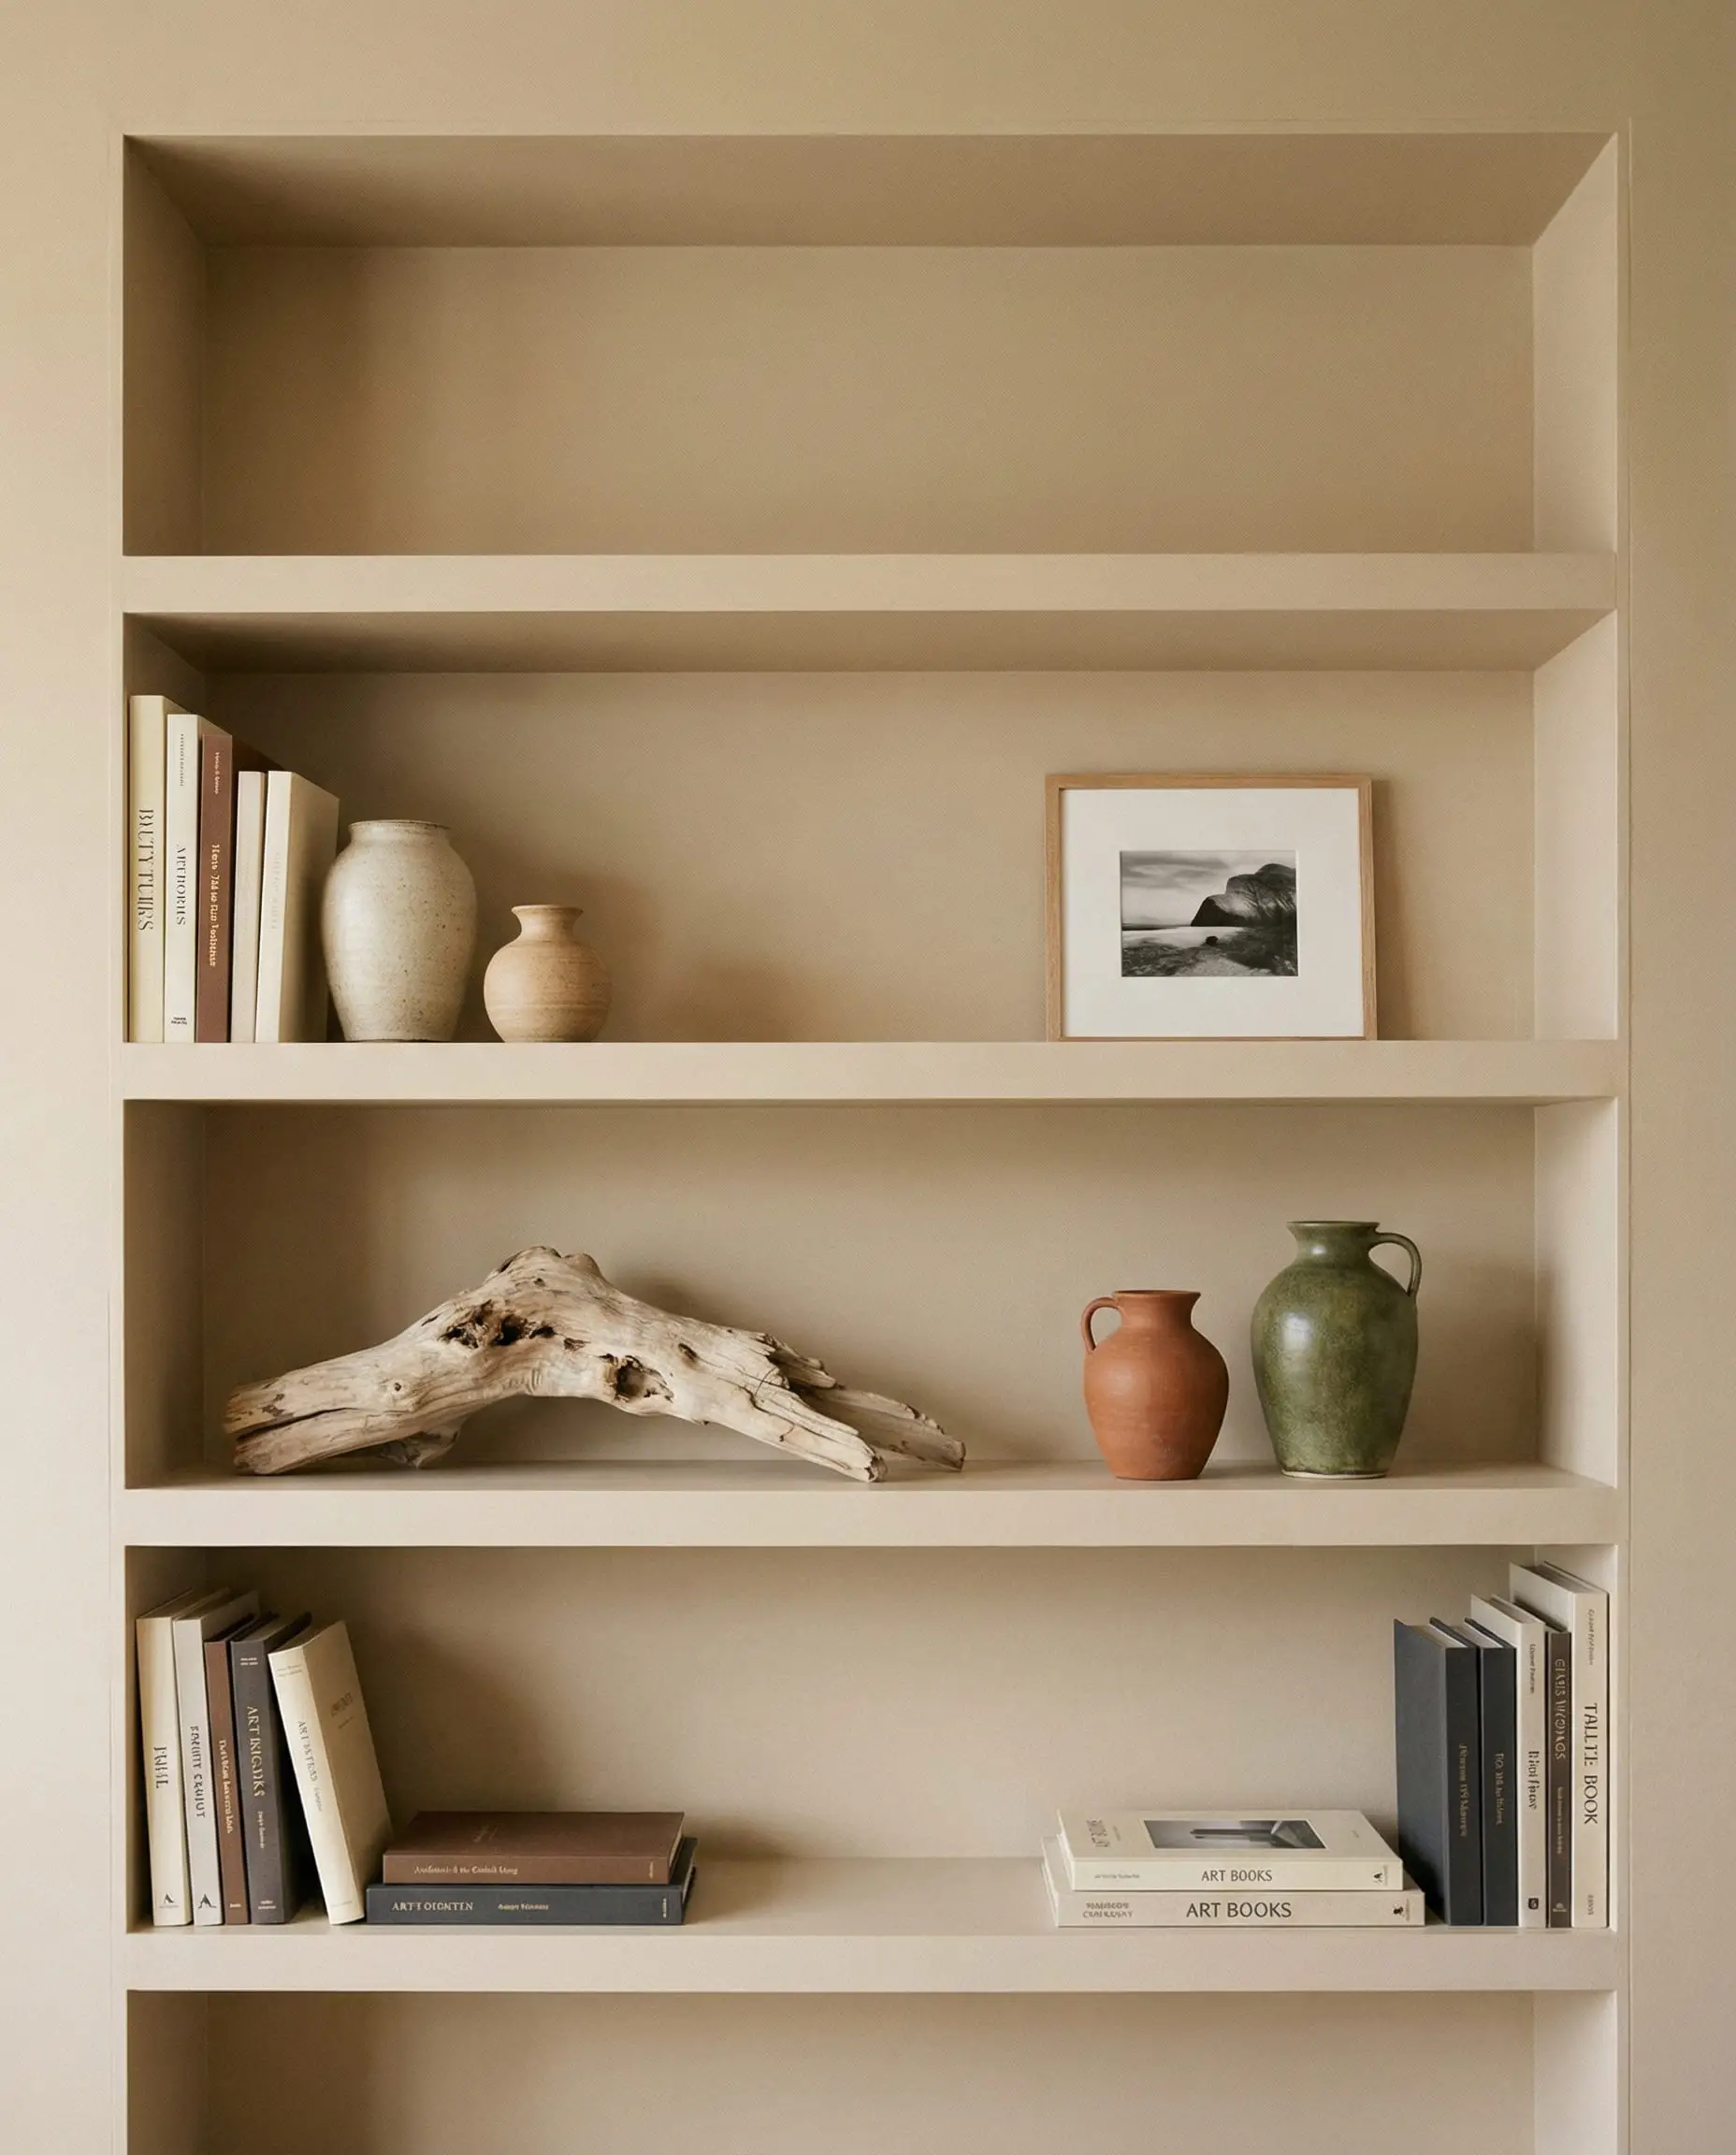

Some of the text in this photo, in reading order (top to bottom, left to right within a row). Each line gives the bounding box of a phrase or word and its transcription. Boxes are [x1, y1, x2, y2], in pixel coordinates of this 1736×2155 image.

[1584, 1774, 1599, 1825] BOOK
[1201, 1870, 1273, 1882] ART BOOKS
[1186, 1902, 1292, 1918] ART BOOKS
